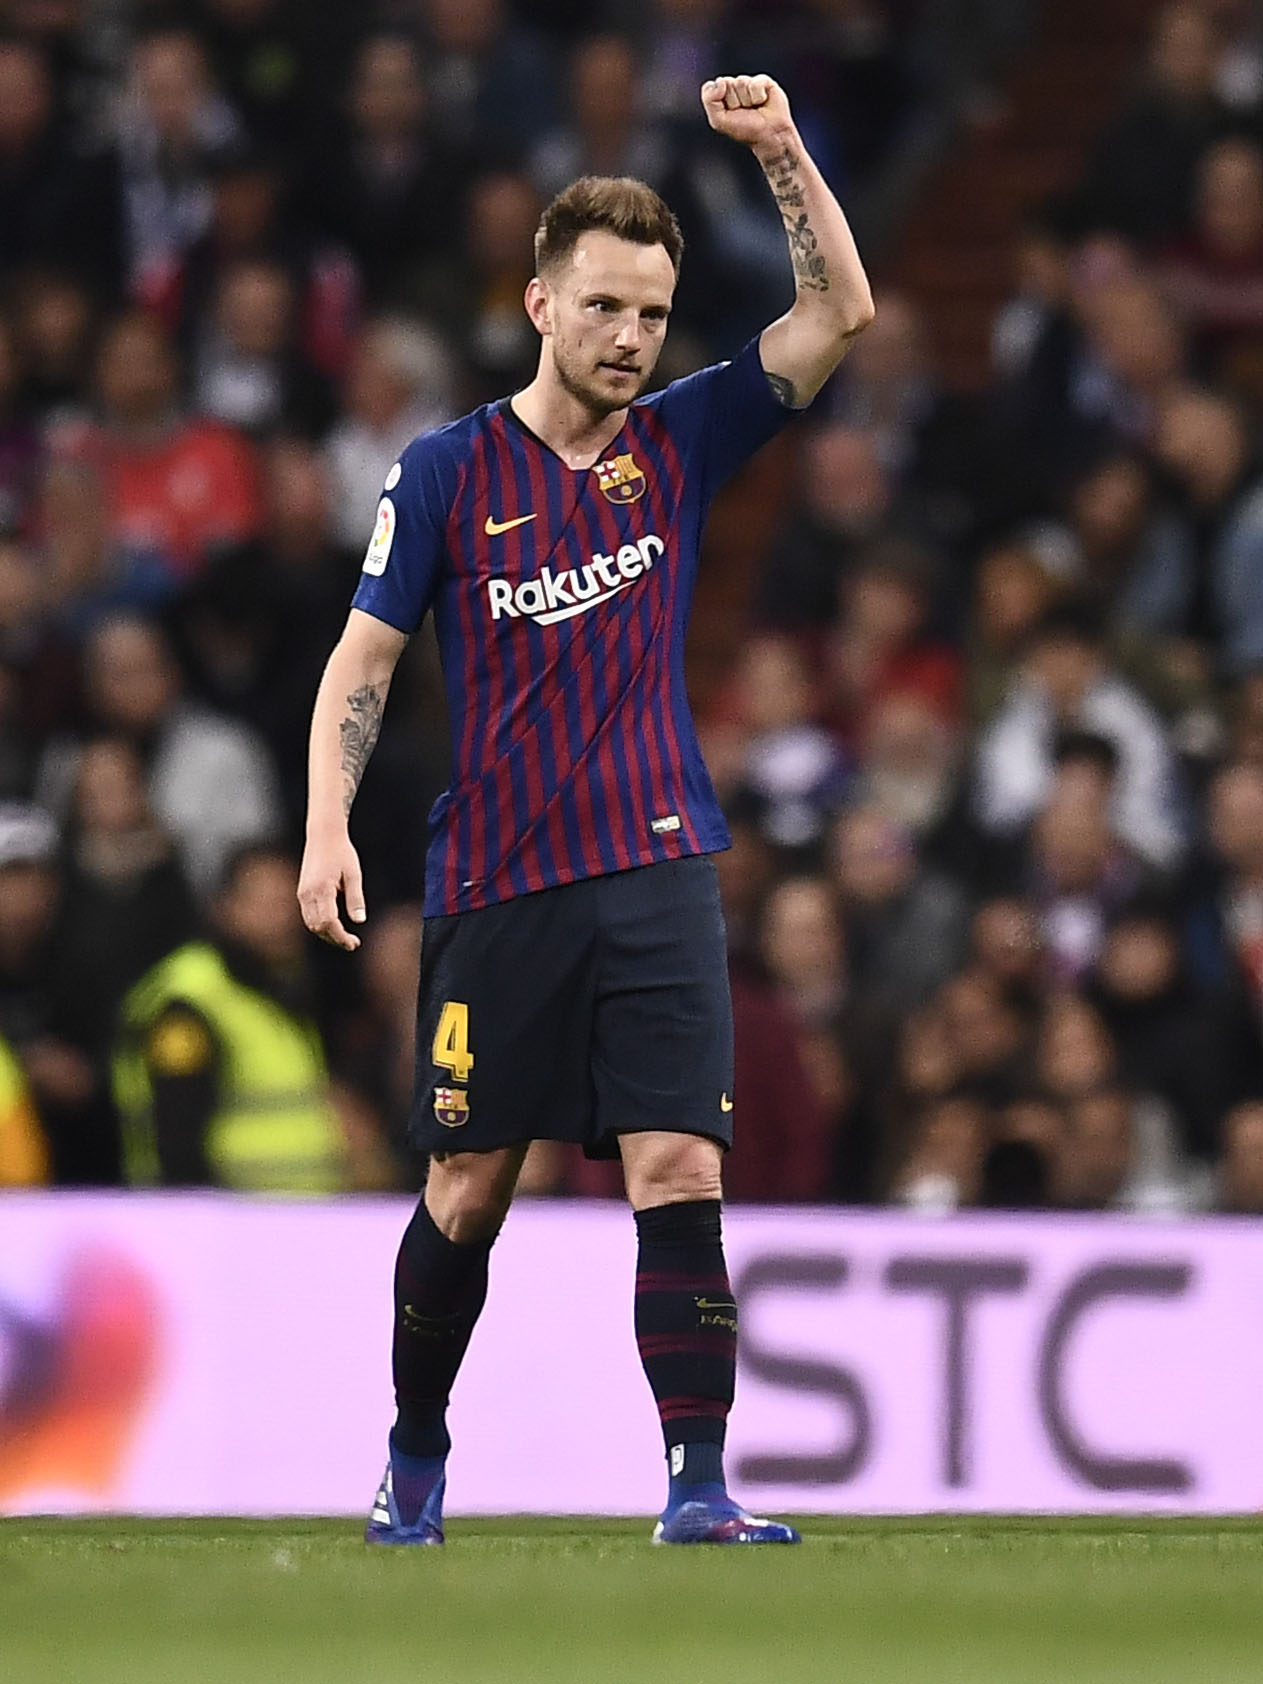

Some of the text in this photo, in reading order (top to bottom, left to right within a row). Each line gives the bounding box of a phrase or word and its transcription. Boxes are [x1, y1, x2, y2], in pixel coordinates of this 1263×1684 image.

[487, 534, 665, 620] Rakuten
[431, 1001, 475, 1082] 4
[732, 1252, 1199, 1492] STC
